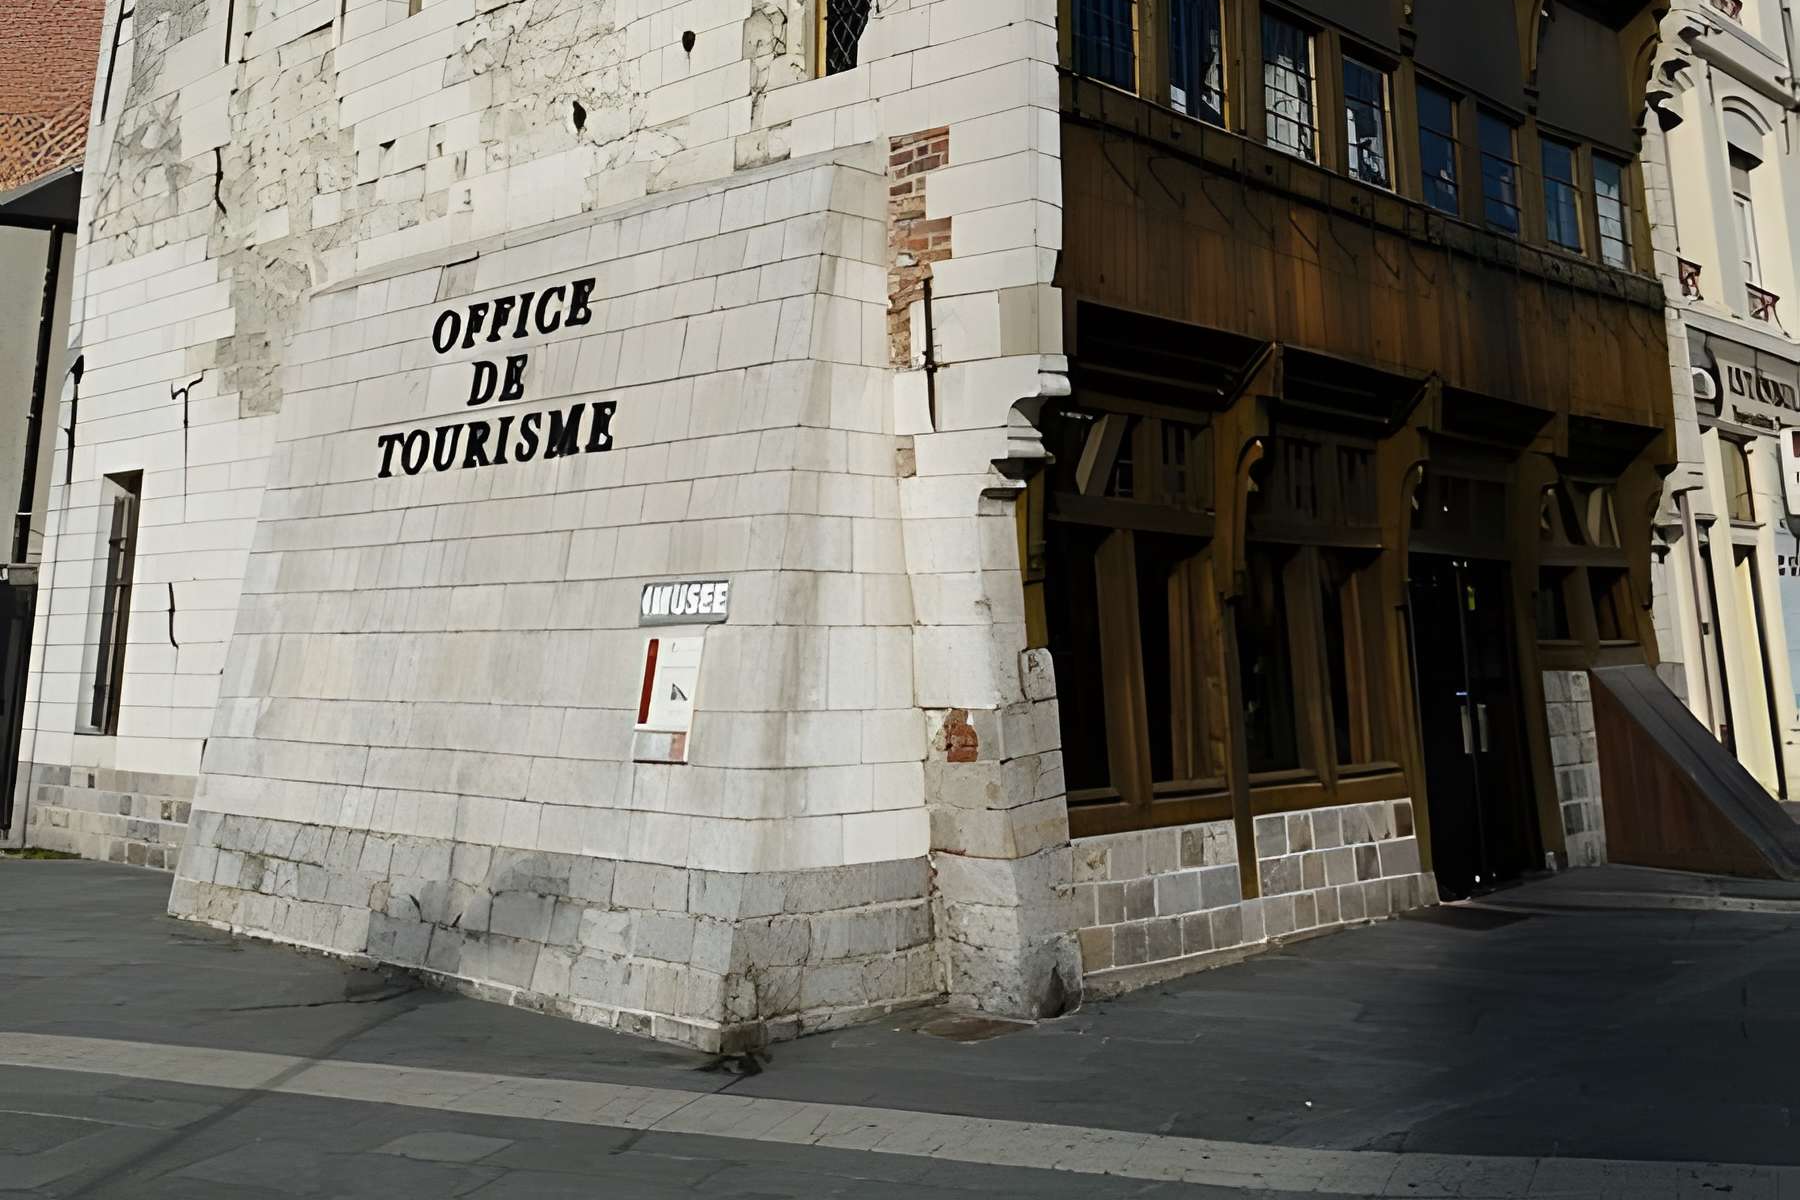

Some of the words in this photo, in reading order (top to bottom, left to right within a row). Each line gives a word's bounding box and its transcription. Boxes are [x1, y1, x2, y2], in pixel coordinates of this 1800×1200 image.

[432, 277, 596, 354] OFFICE
[466, 353, 528, 406] DE
[377, 400, 617, 478] TOURISME
